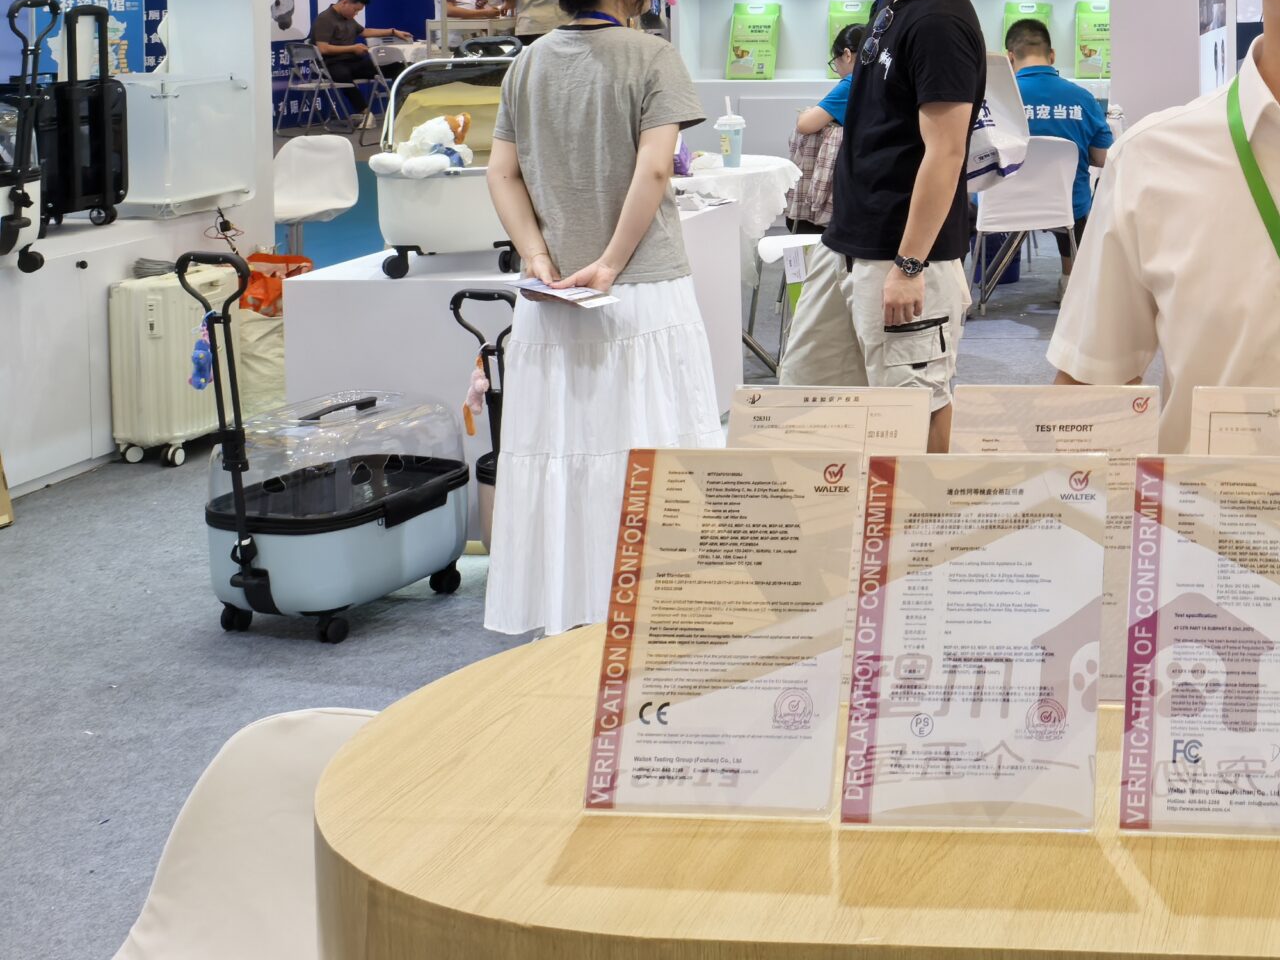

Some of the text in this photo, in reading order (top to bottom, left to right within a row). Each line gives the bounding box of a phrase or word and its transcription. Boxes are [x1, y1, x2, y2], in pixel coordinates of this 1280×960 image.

[1035, 424, 1093, 432] TEST REPORT
[814, 485, 850, 493] WALTEK
[1060, 493, 1096, 501] WALTEK
[590, 463, 650, 804] VERIFICATION OF CONFORMITY
[845, 476, 888, 800] DECLARATION OF CONFORMITY
[1126, 473, 1160, 823] VERIFICATION OF CONFORMITY
[639, 701, 670, 725] CE
